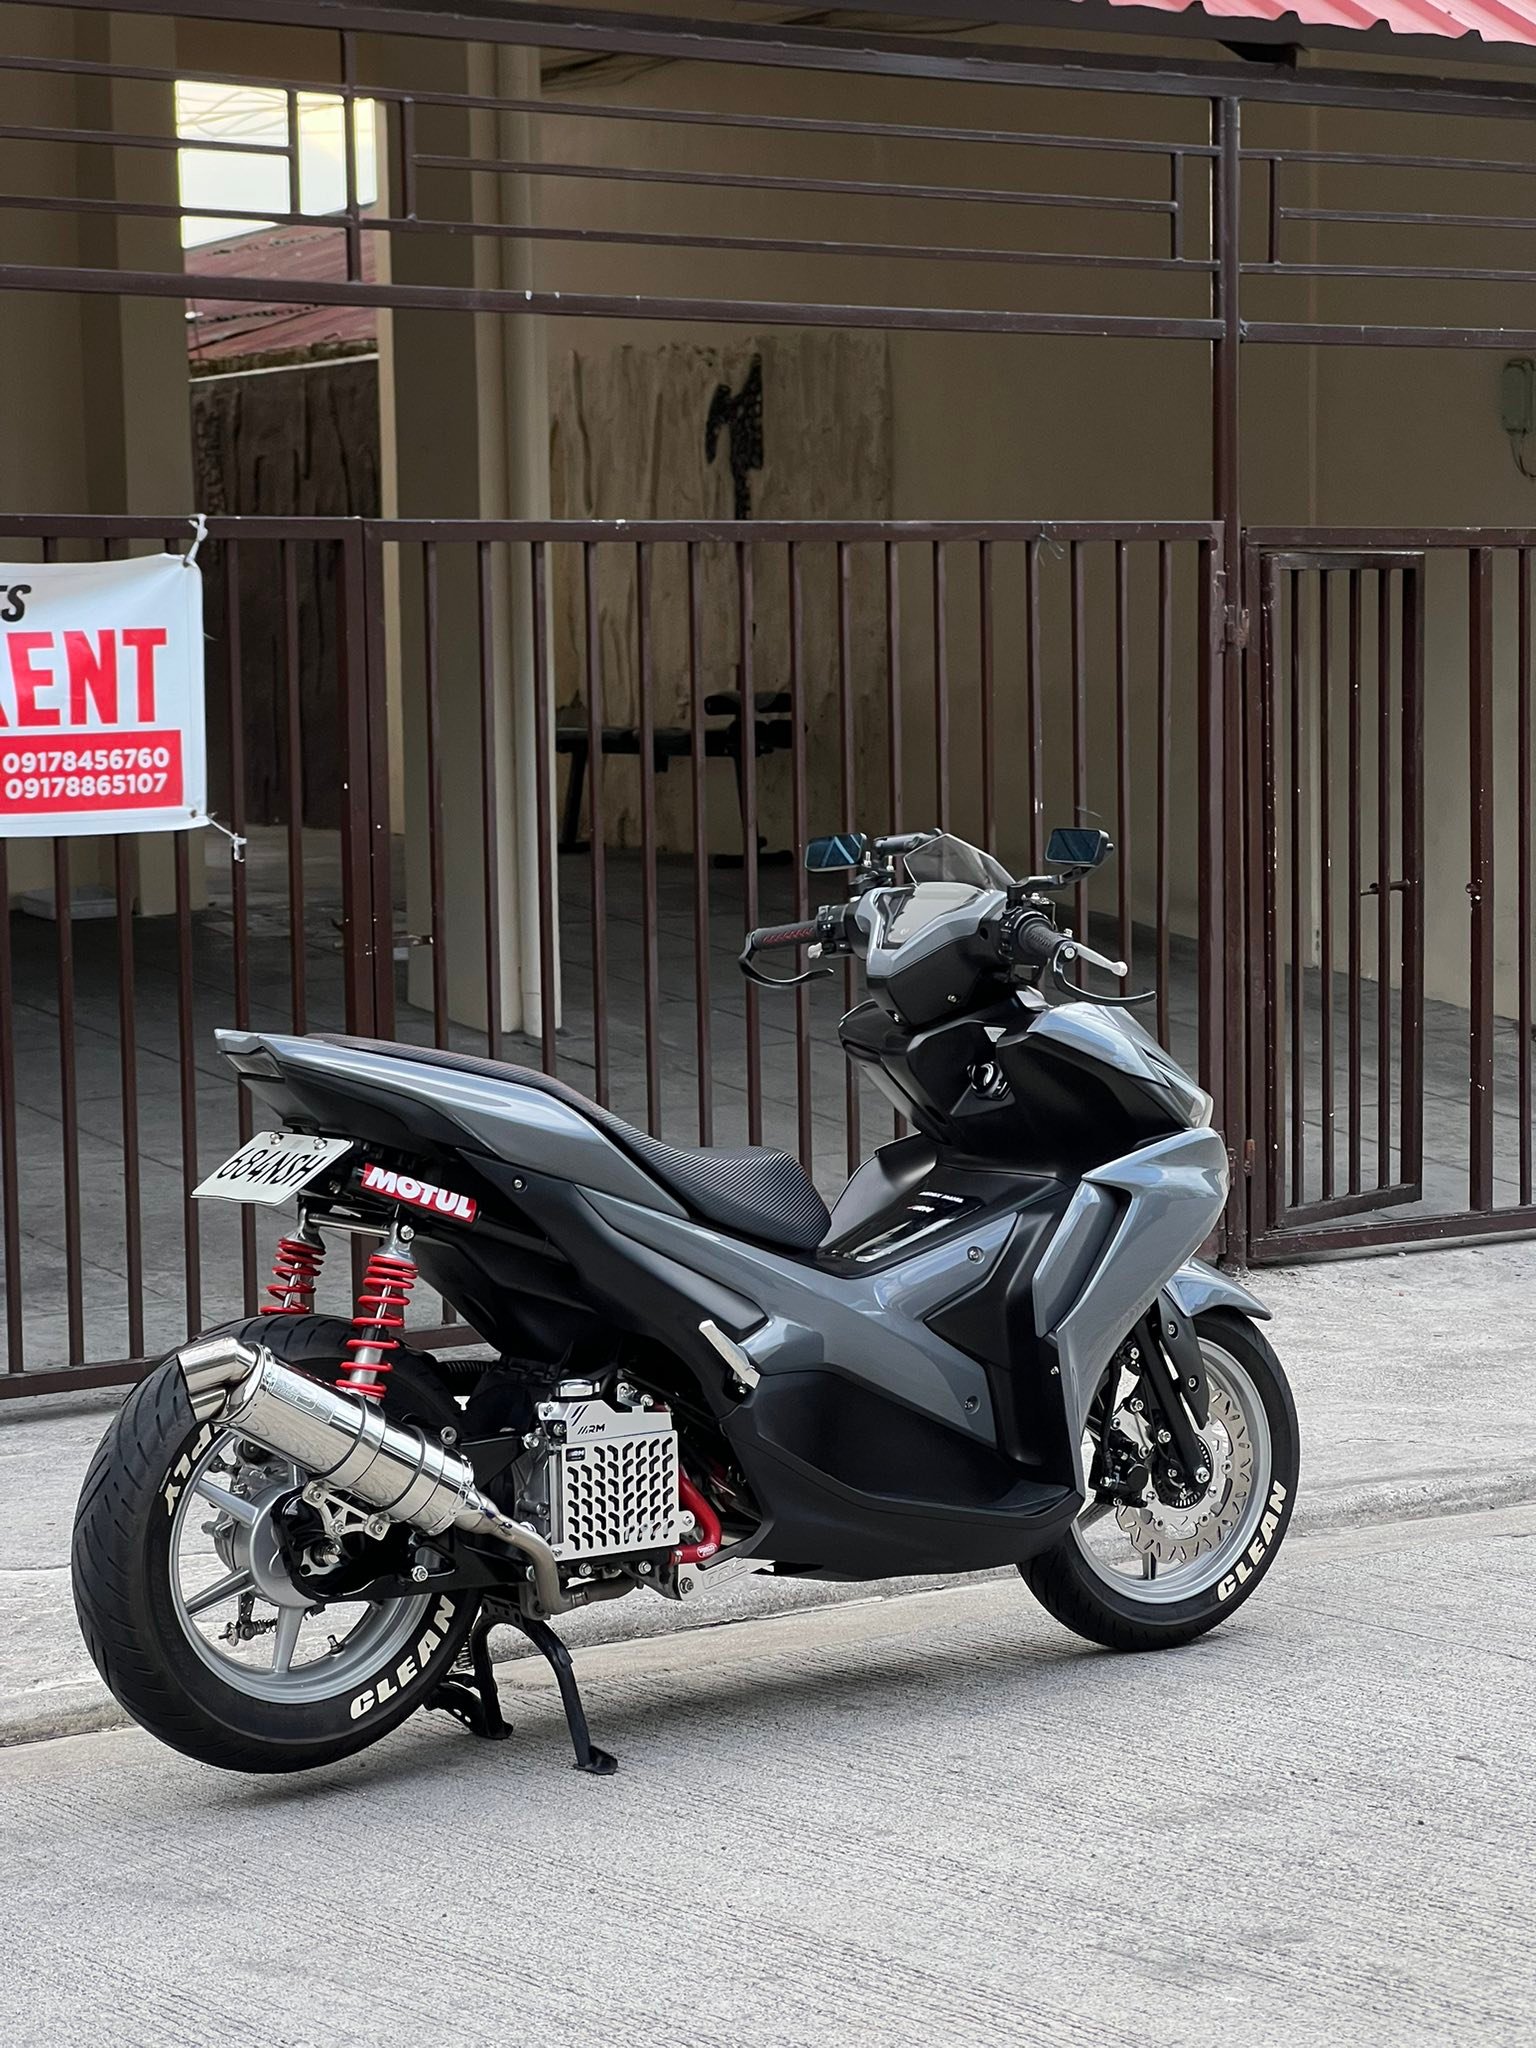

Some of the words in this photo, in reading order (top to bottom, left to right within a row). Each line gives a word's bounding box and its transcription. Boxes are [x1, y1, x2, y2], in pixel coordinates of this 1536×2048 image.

[0, 628, 167, 727] ENT
[2, 748, 170, 774] 09178456760
[5, 773, 168, 799] 09178865107
[216, 1147, 328, 1187] 684NSH
[365, 1167, 475, 1219] MOTUL
[164, 1422, 218, 1517] PLY
[1217, 1480, 1287, 1602] CLEAN
[350, 1594, 456, 1720] CLEAN
